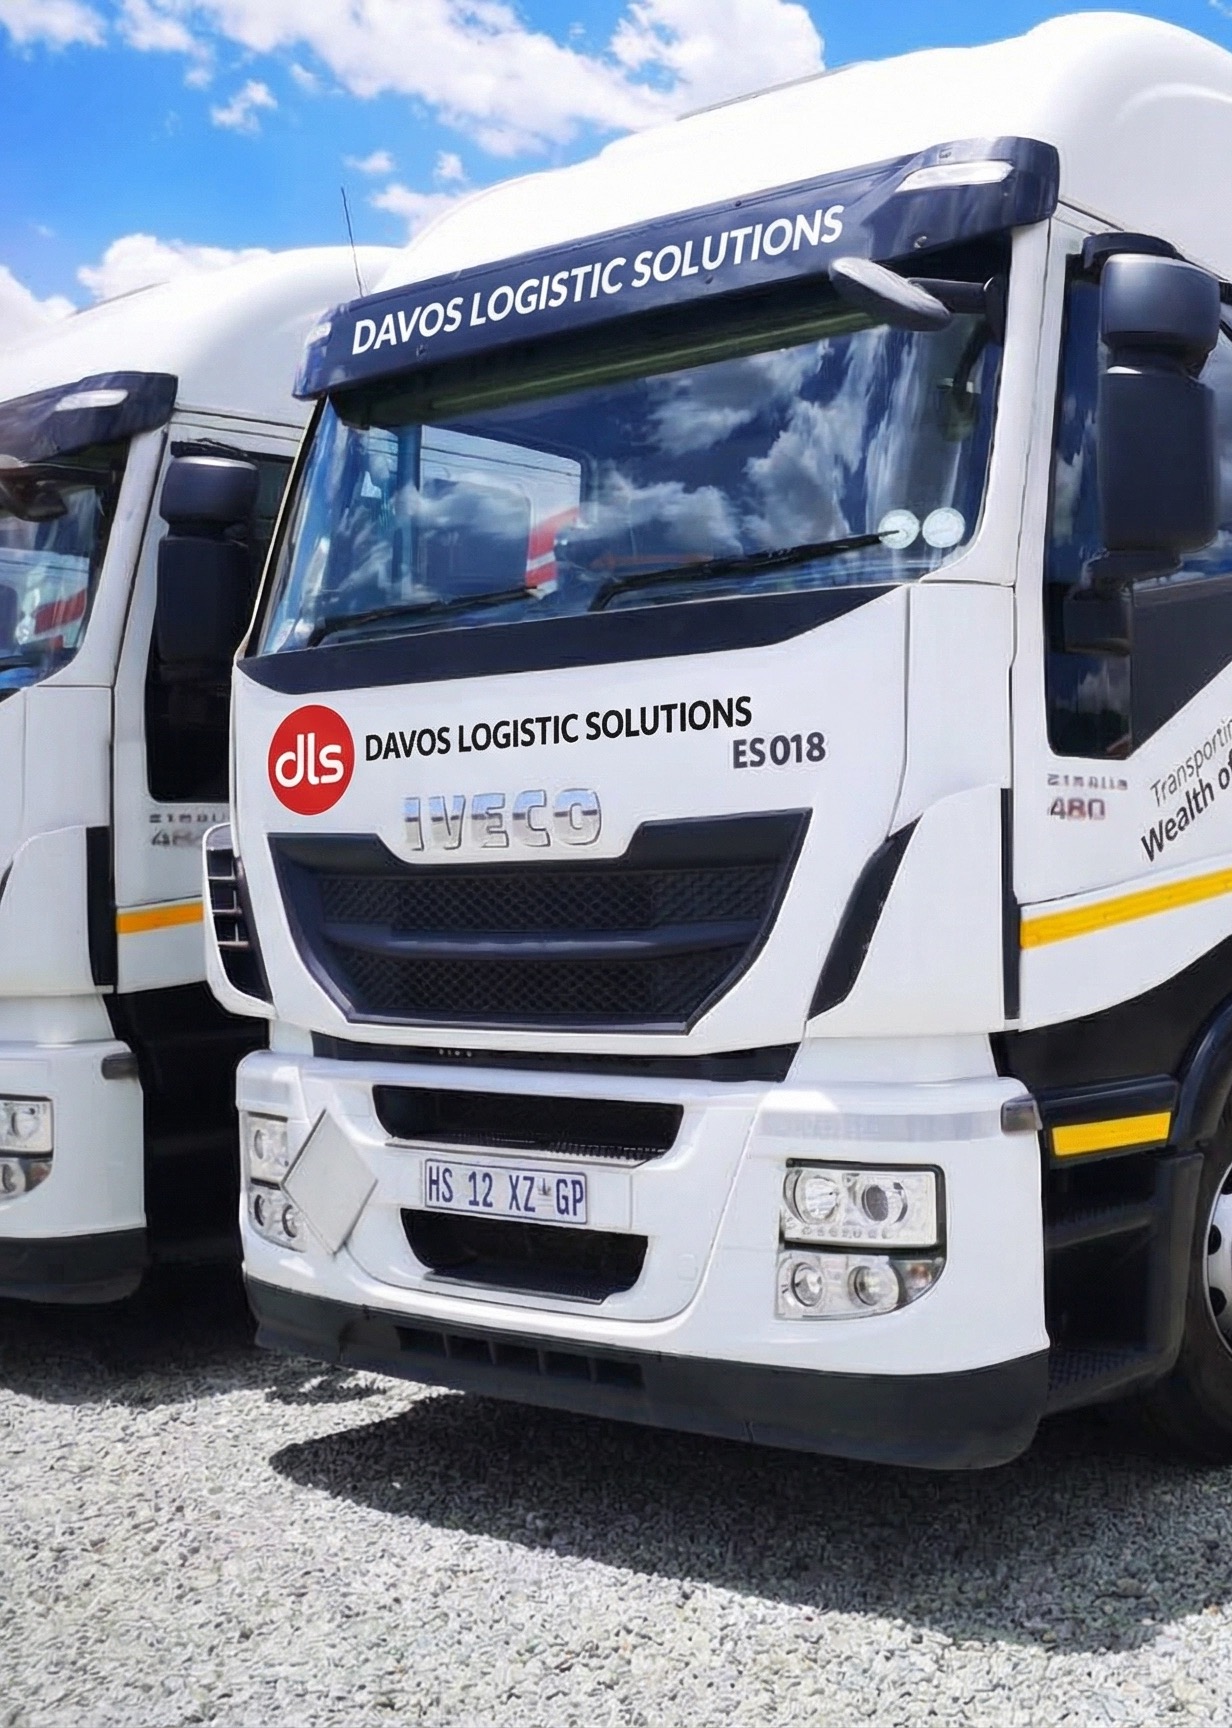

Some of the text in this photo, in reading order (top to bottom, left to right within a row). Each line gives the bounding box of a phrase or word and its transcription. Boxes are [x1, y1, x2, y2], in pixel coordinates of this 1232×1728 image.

[352, 204, 845, 355] DAVOS LOGISTIC SOLUTIONS
[275, 733, 344, 788] dls
[365, 695, 752, 762] DAVOS LOGISTIC SOLUTIONS
[733, 731, 826, 769] ES018
[403, 787, 602, 852] IVECO
[1140, 778, 1215, 862] Wealth
[428, 1165, 584, 1217] HS 12 XZ GP
